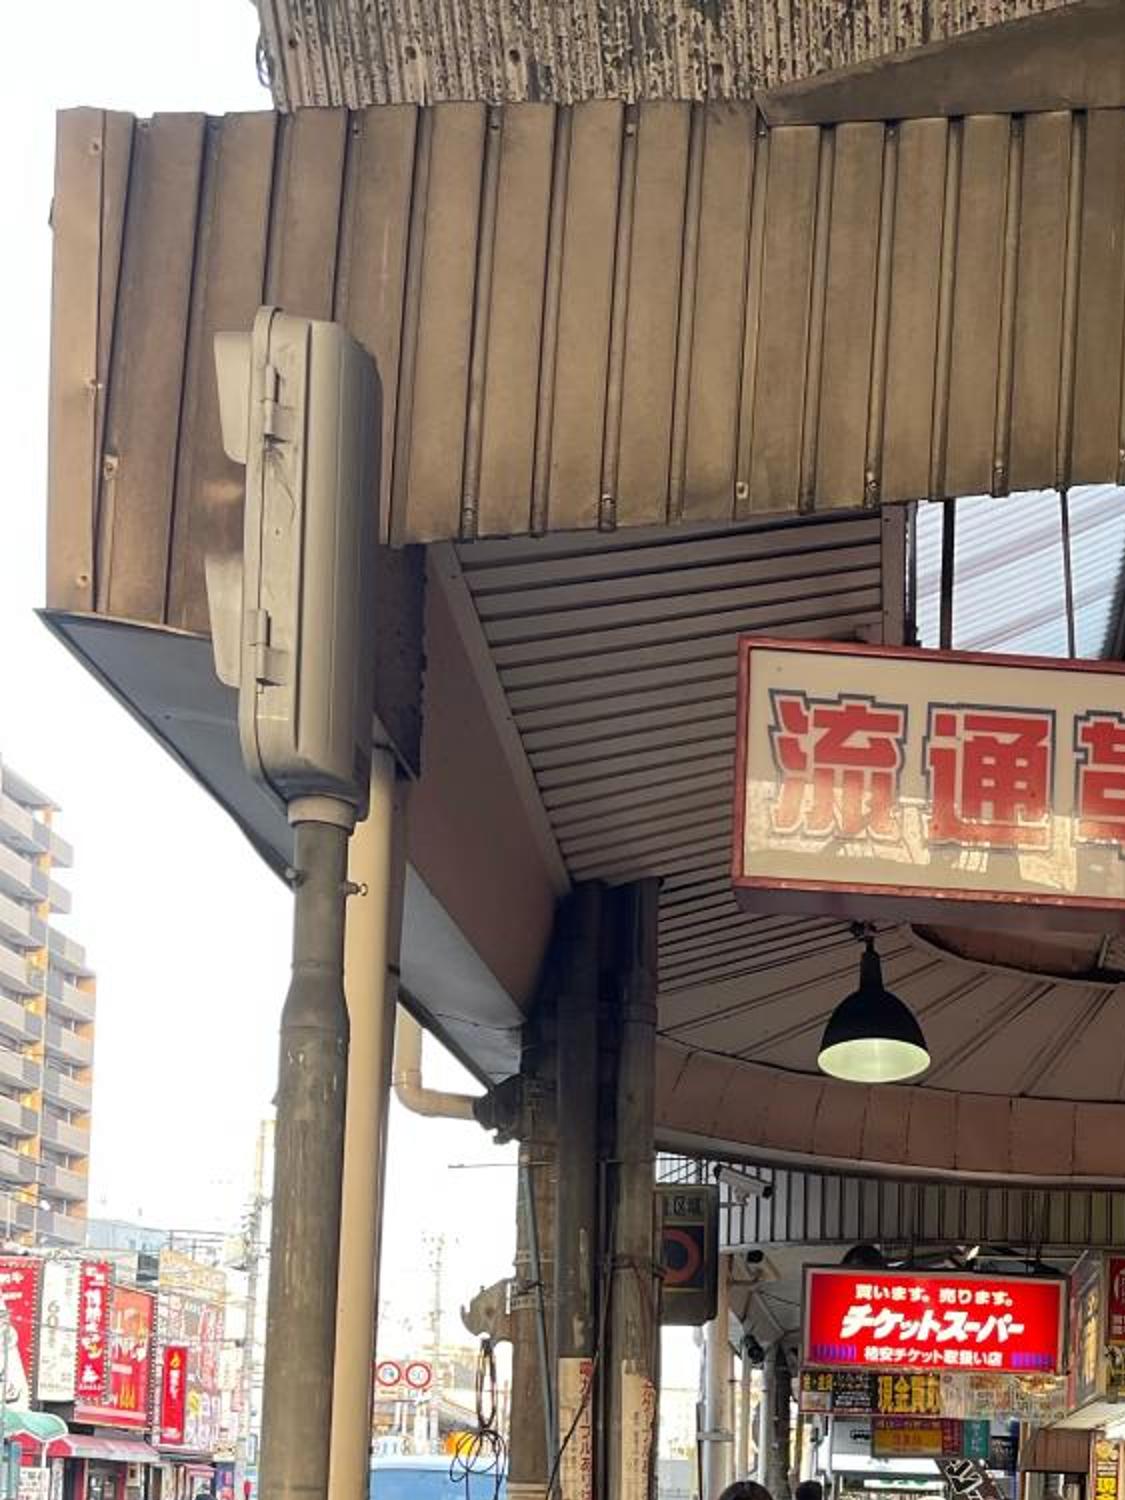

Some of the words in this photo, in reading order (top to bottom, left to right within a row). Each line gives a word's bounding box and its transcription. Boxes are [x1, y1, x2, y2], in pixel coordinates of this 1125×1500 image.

[855, 1283, 1013, 1307] 買います。売ります。
[840, 1304, 1024, 1342] チケットスーパー
[864, 1345, 1003, 1367] 格安チケット取扱い店
